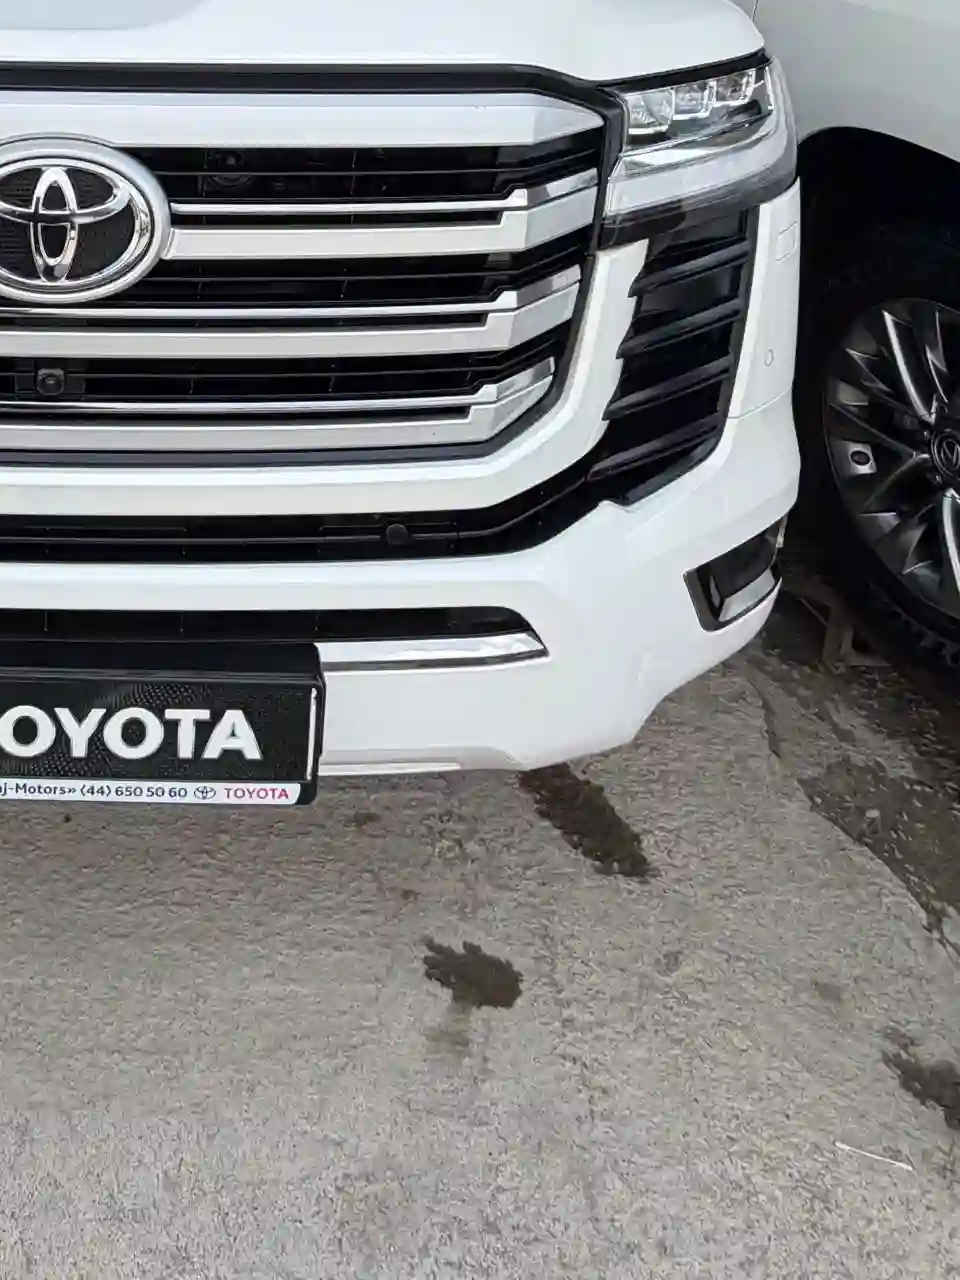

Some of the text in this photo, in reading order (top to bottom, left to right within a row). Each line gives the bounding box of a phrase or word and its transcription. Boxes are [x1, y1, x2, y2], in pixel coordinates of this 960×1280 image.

[79, 784, 112, 799] (44)
[115, 784, 143, 797] 650
[146, 785, 165, 798] 50
[168, 786, 188, 799] 60
[224, 786, 289, 800] TOYOTA
